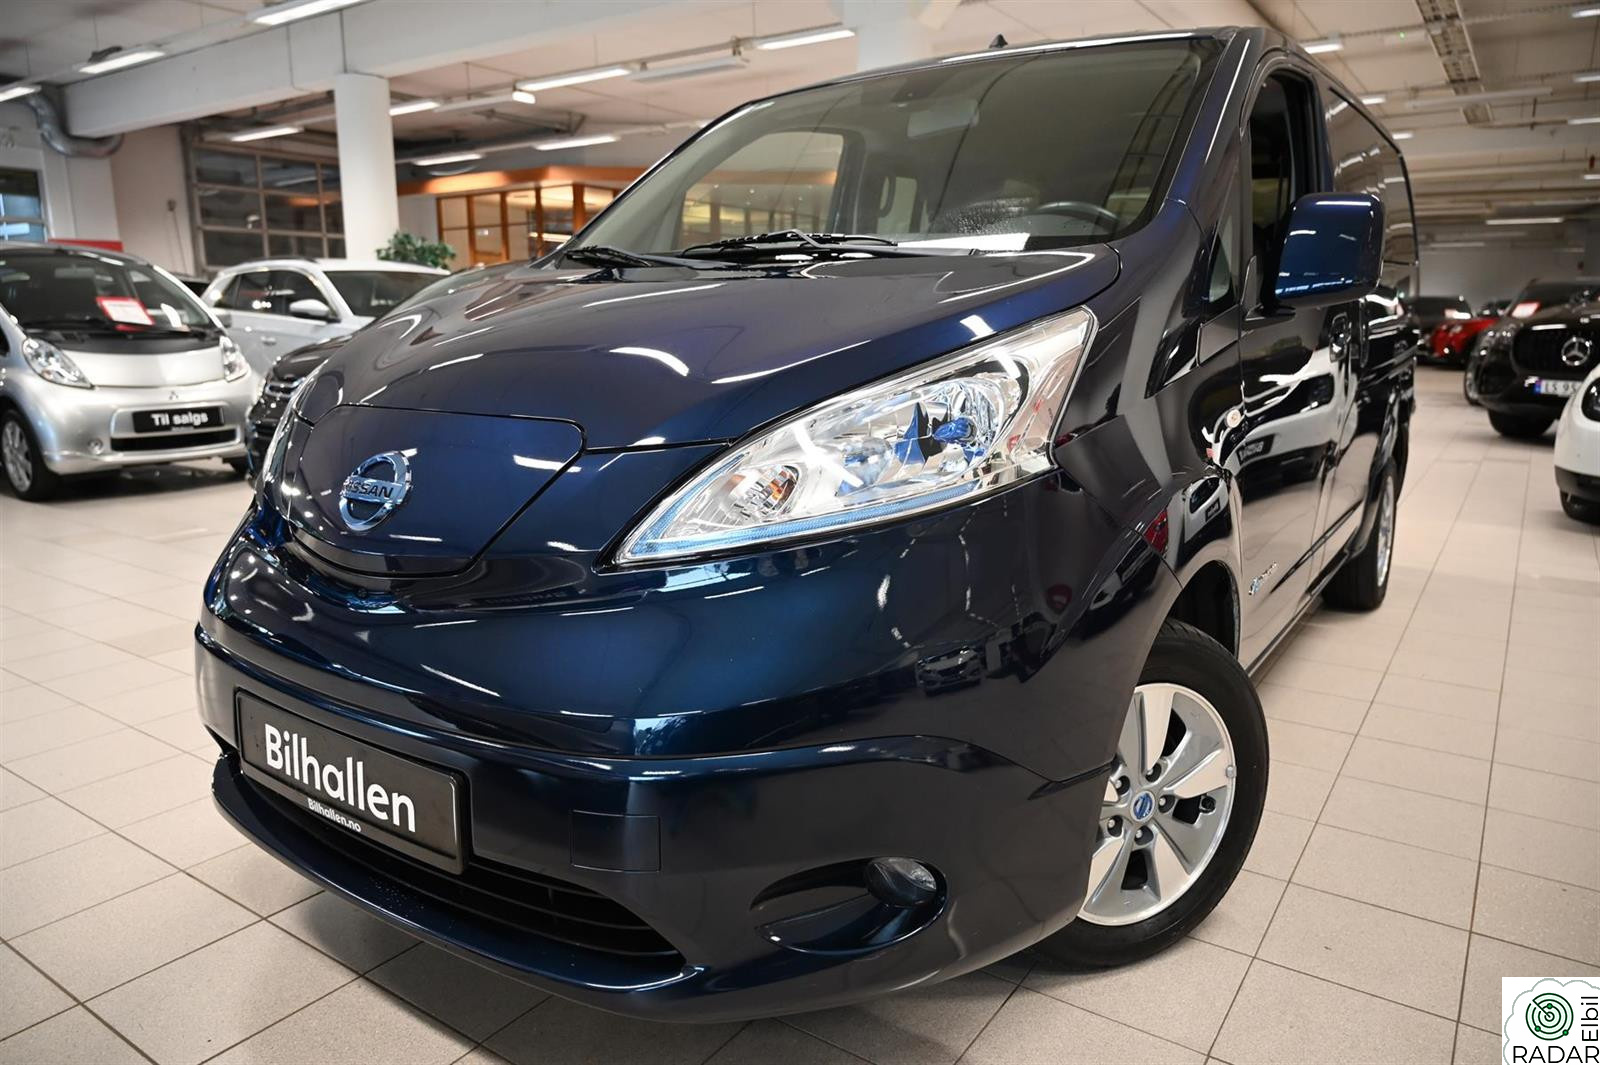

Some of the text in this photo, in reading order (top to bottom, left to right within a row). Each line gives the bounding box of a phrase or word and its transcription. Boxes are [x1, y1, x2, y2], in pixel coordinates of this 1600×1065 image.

[151, 411, 209, 426] Til salgs
[264, 723, 416, 833] Bilhallen
[307, 797, 362, 832] Bilhallen.no
